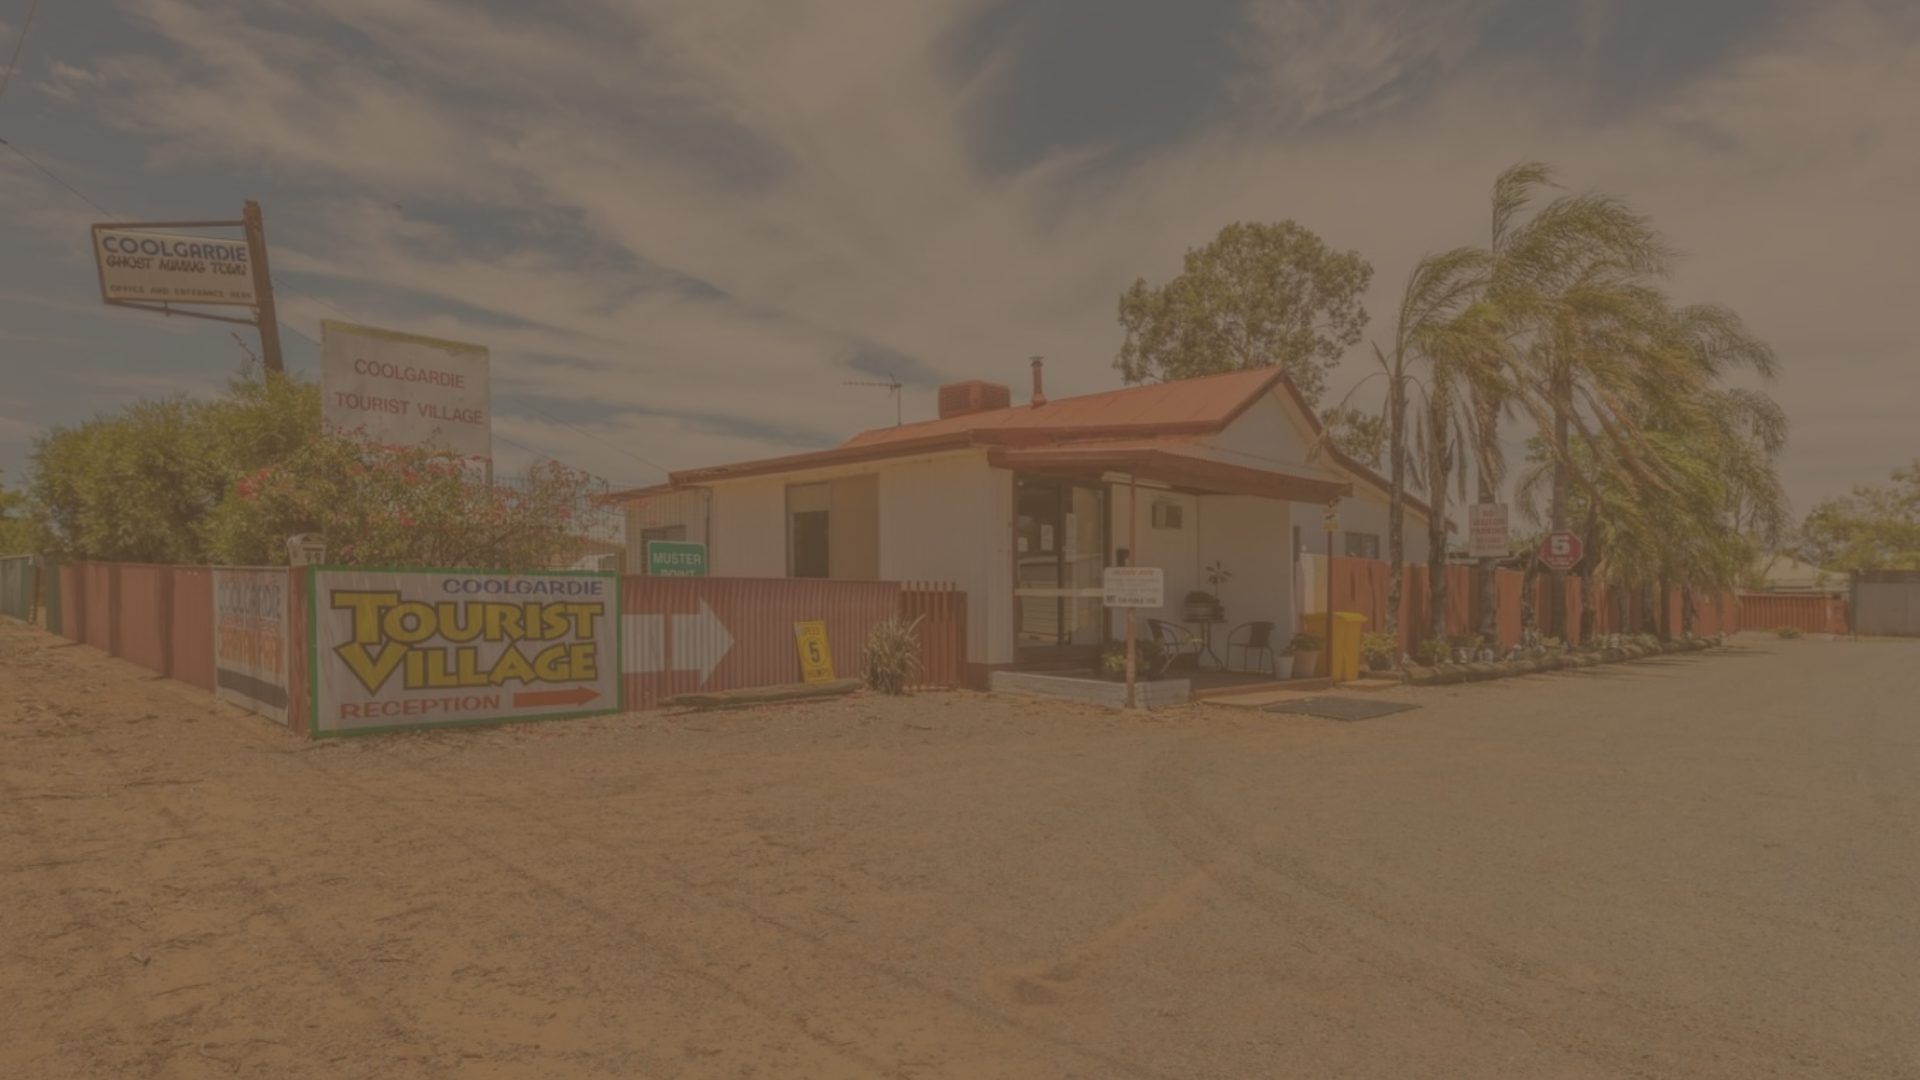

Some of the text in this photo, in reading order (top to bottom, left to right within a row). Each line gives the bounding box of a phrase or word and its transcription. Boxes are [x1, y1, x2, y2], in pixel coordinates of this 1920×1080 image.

[102, 236, 248, 262] COOLGARDIE
[106, 254, 247, 276] GHOST MINING TOWN
[109, 284, 144, 293] OFFICE
[150, 286, 169, 295] AND
[354, 358, 465, 389] COOLGARDIE
[336, 392, 483, 425] TOURIST VILLAGE
[1551, 535, 1570, 555] 5
[653, 552, 701, 565] MUSTER
[442, 579, 603, 595] COOLGARDIE
[330, 590, 604, 645] TOURIST
[808, 641, 821, 663] 5
[333, 640, 598, 696] VILLAGE
[340, 695, 500, 719] RECEPTION
